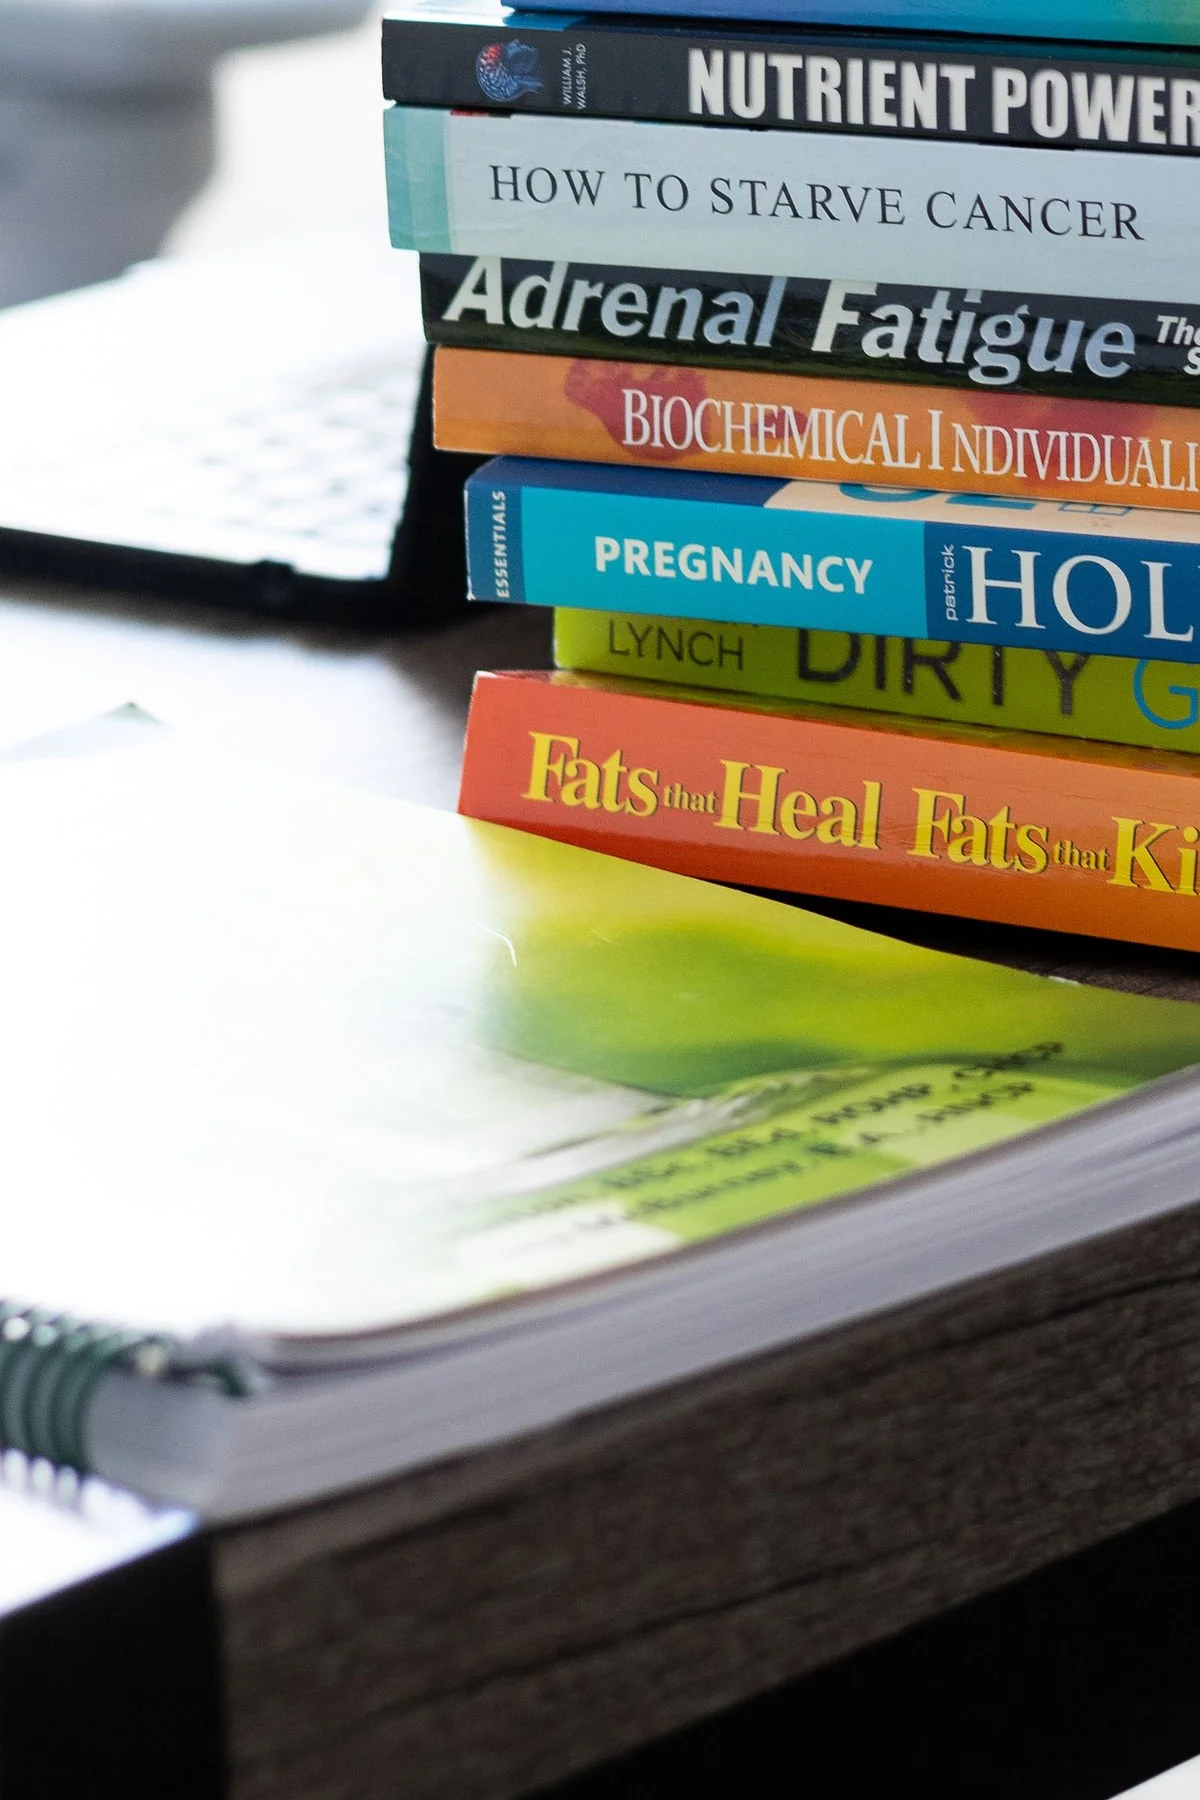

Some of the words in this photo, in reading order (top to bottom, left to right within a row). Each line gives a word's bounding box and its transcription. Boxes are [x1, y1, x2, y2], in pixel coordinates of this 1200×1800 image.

[562, 58, 572, 105] WILLIAM
[576, 43, 586, 64] PhD
[576, 67, 589, 110] WALSH,
[689, 47, 975, 131] NUTRIENT
[489, 164, 605, 206] HOW
[625, 172, 690, 211] TO
[711, 177, 905, 224] STARVE
[926, 191, 1145, 240] CANCER
[442, 255, 788, 347] Adrenal
[811, 279, 1136, 385] Fatigue
[622, 389, 922, 470] BIOCHEMICAL
[495, 489, 510, 598] ESSENTIALS
[594, 536, 873, 595] PREGNANCY
[945, 543, 958, 621] patrick
[609, 620, 743, 671] LYNCH
[797, 627, 1092, 715] DIRTY
[522, 731, 660, 816] Fats
[663, 784, 717, 816] that
[715, 760, 882, 850] Heal
[907, 787, 1050, 875] Fats
[1052, 837, 1110, 872] that
